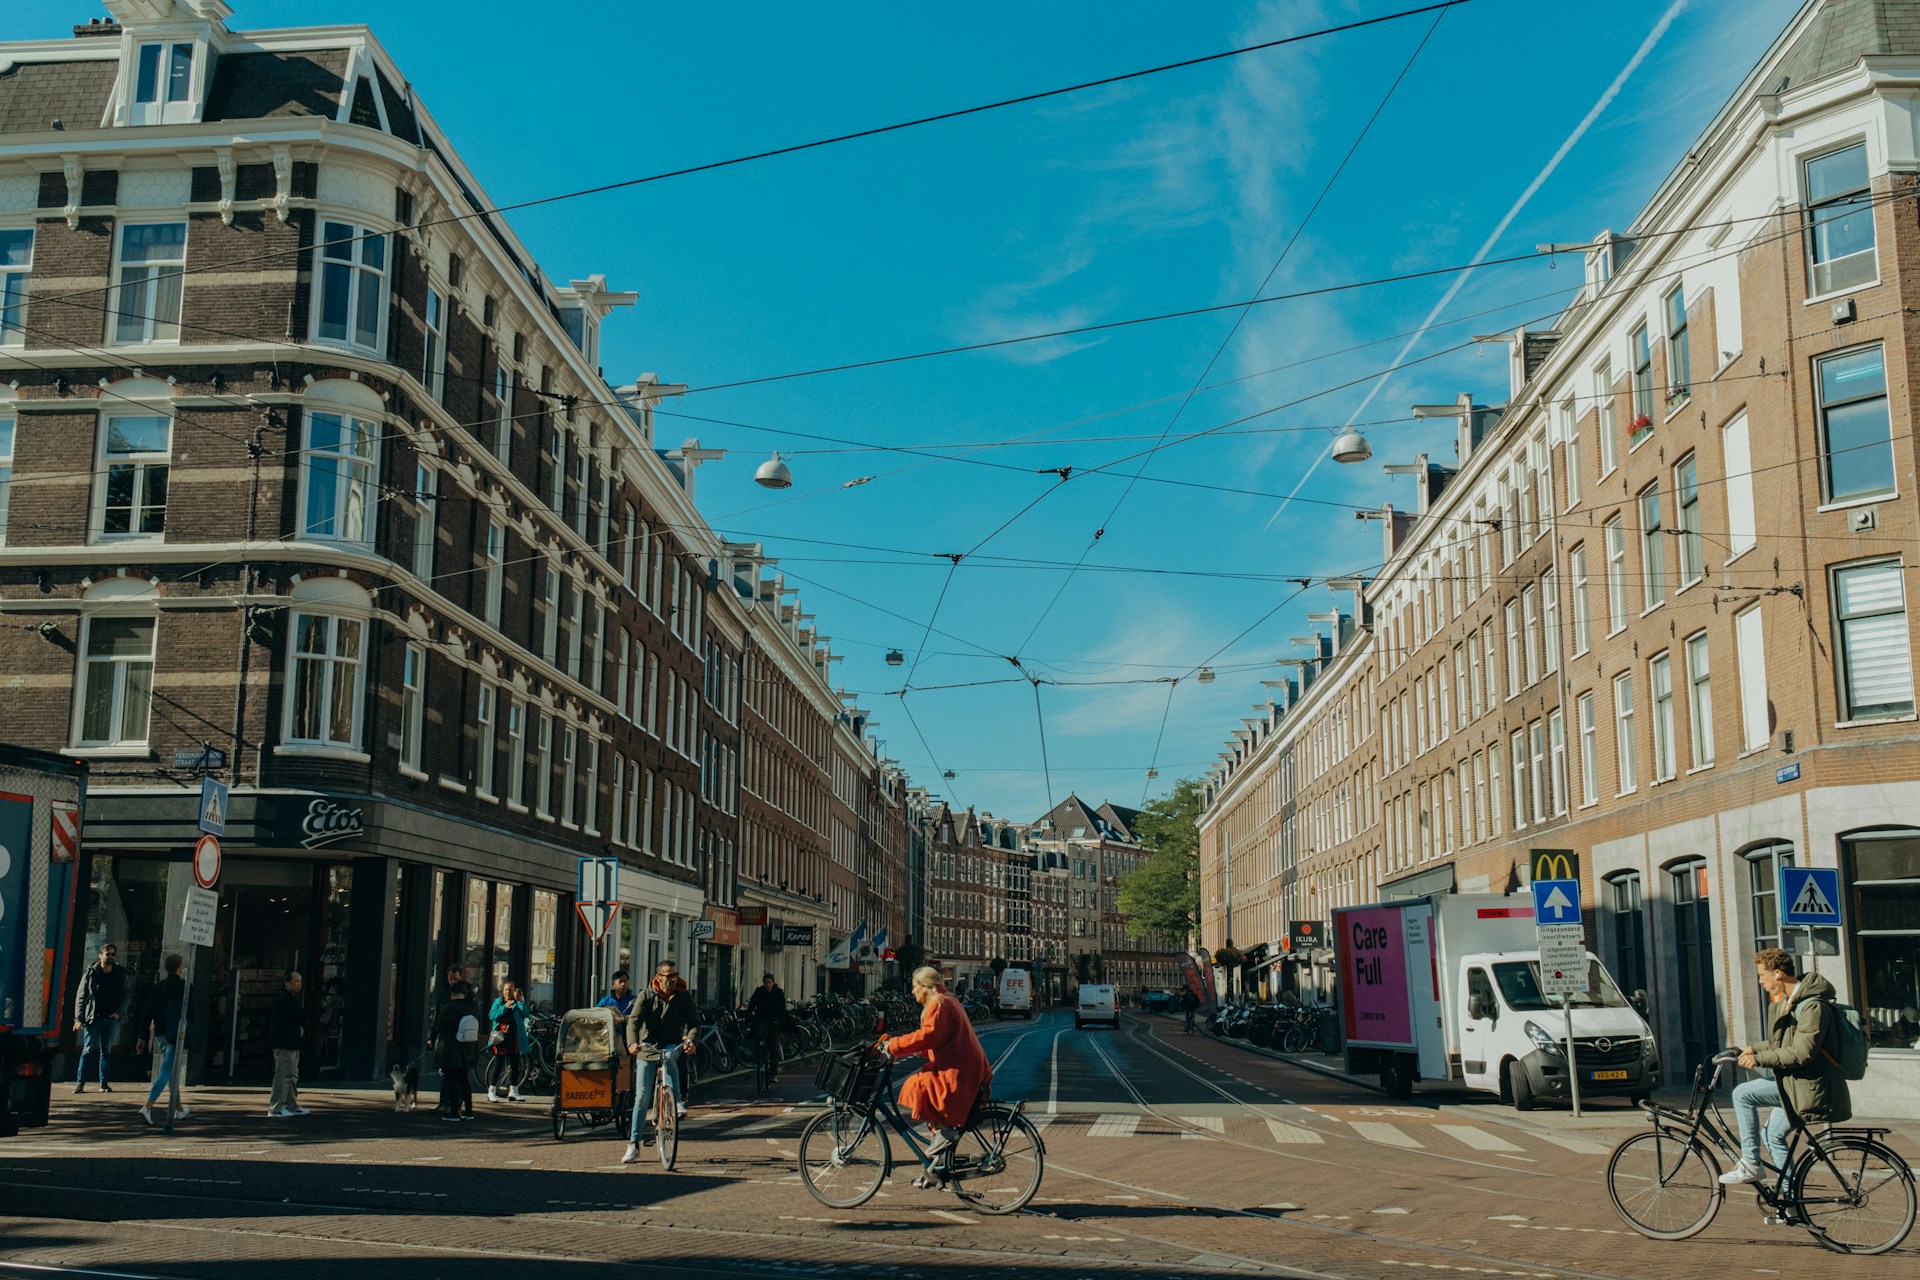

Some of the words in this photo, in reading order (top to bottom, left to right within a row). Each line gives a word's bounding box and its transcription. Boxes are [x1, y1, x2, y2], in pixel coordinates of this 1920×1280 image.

[302, 799, 363, 837] Etos
[694, 922, 712, 934] Etos
[786, 932, 811, 941] Korea
[1353, 922, 1388, 950] Care
[1356, 956, 1382, 986] Full
[1006, 980, 1024, 988] EFE
[566, 1092, 596, 1100] BABBOE
